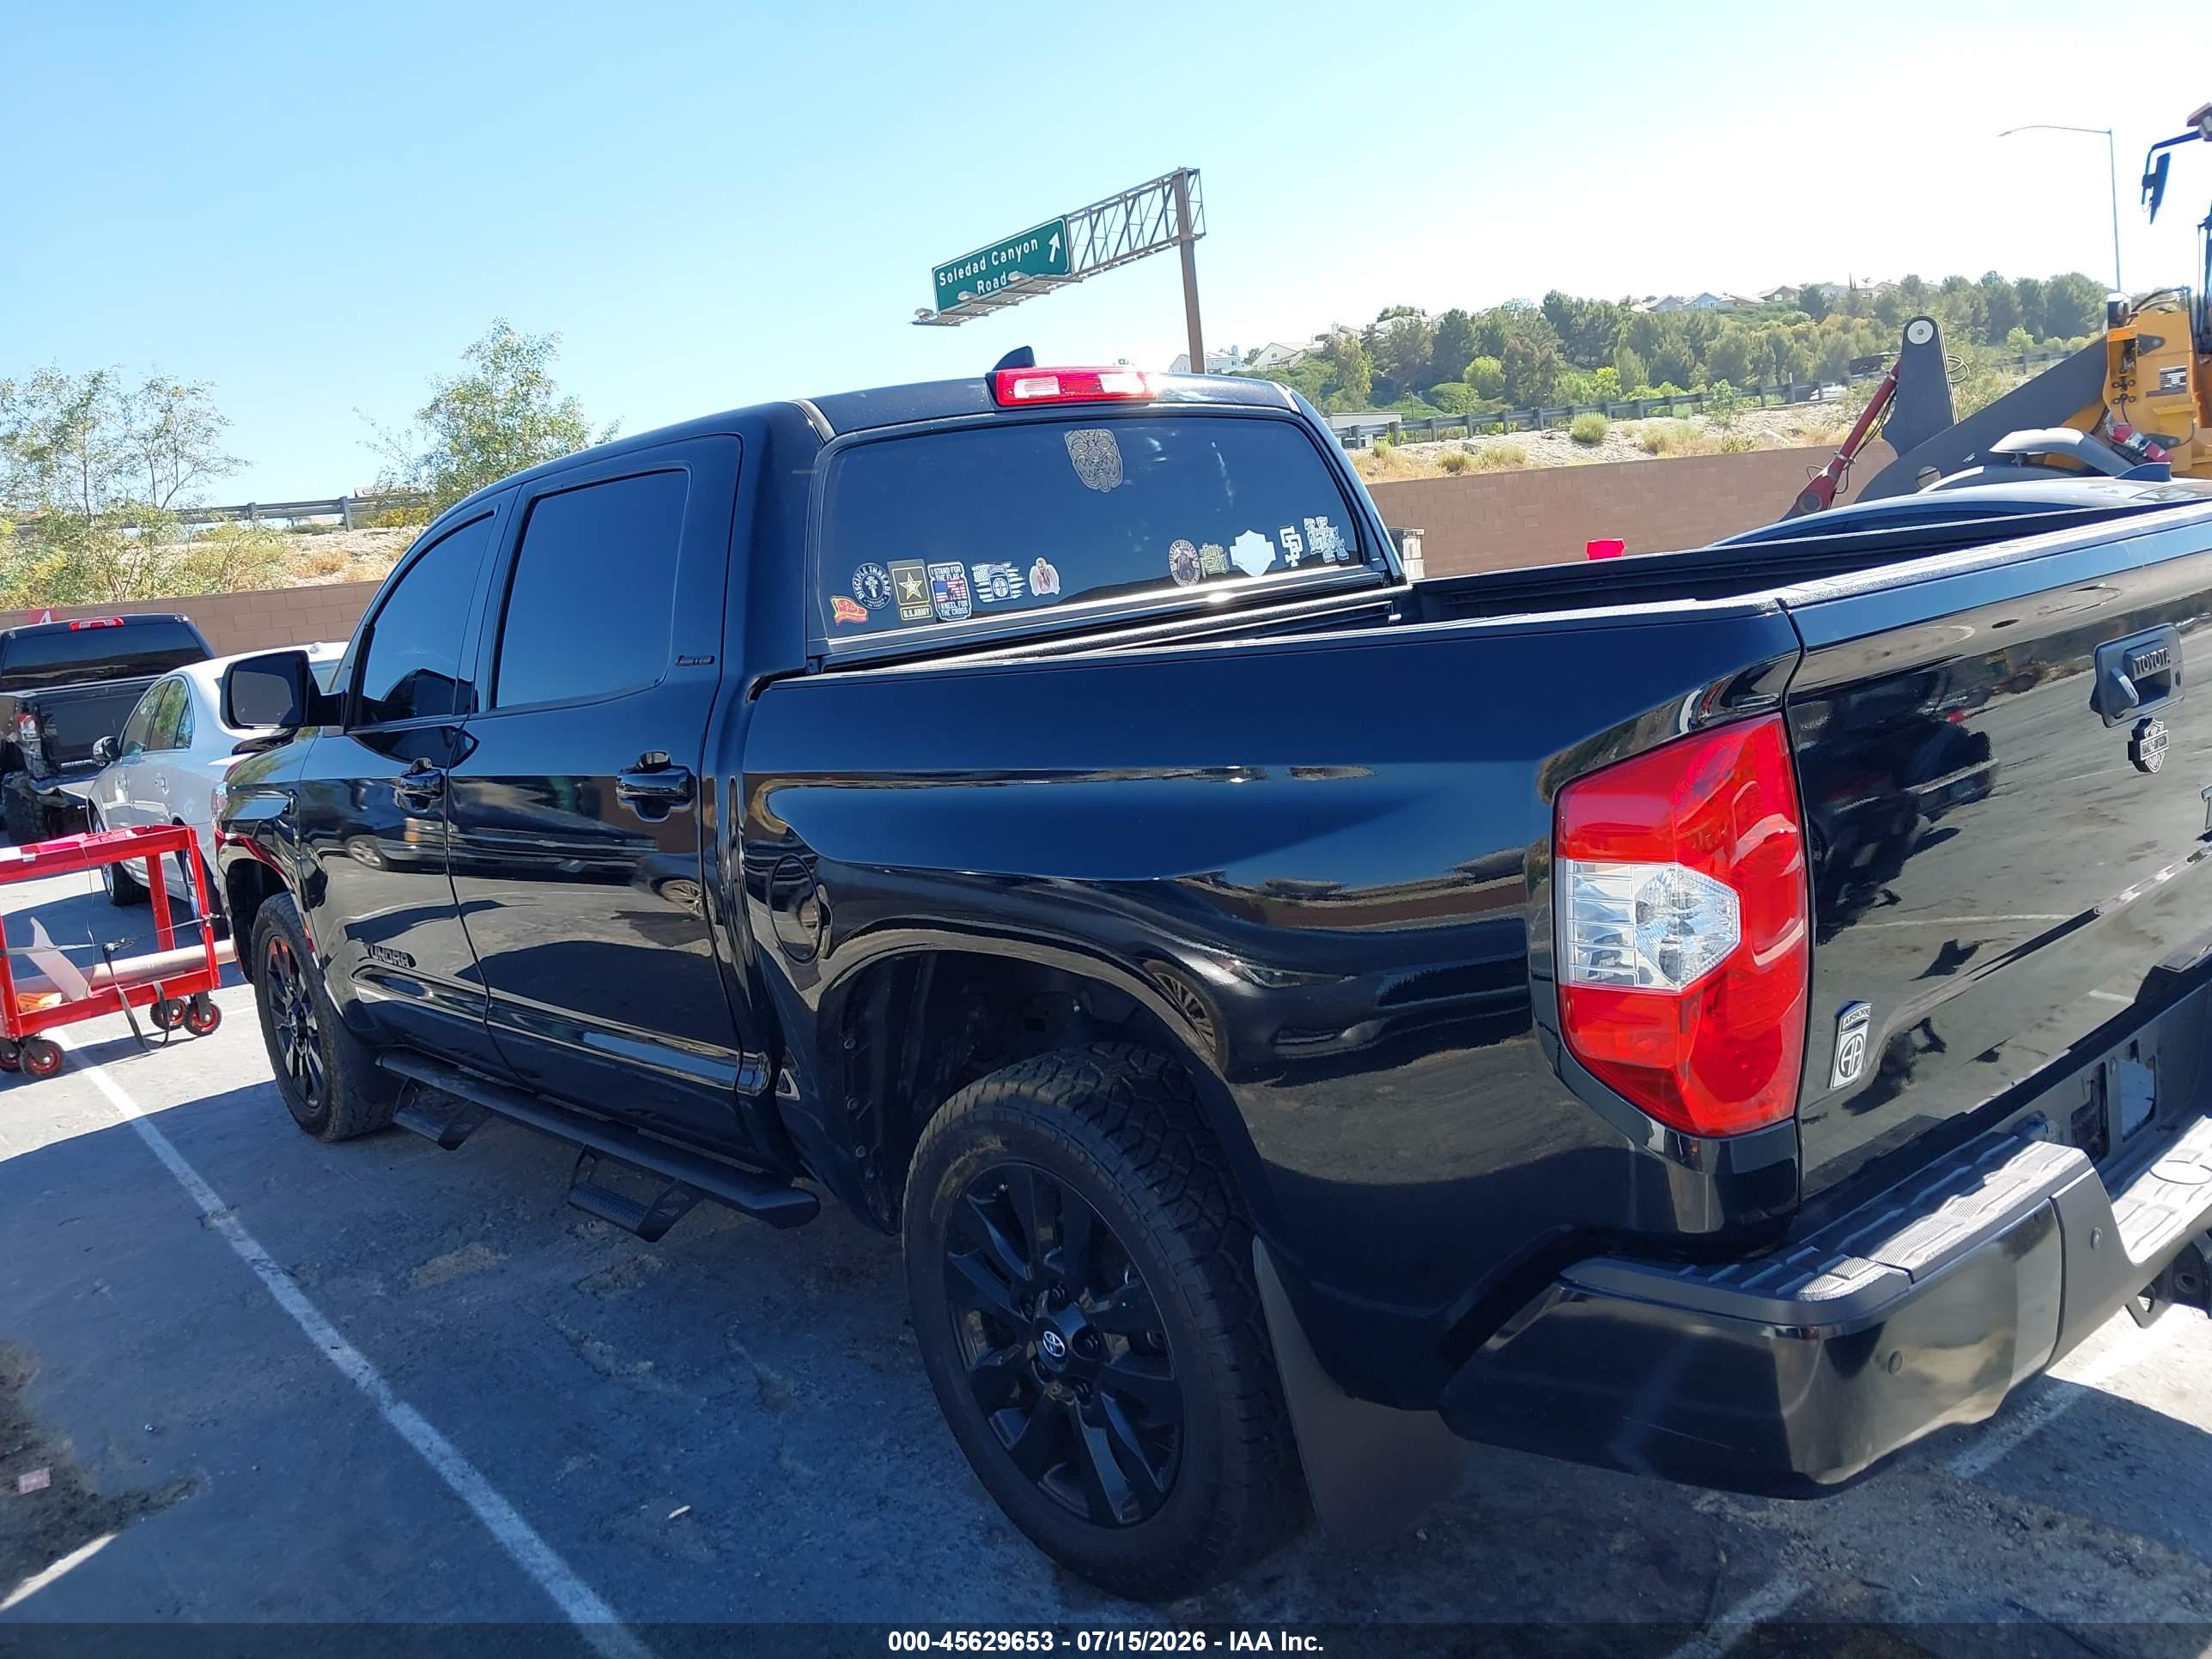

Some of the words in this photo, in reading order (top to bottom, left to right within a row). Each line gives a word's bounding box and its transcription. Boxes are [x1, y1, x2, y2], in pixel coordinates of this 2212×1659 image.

[939, 256, 987, 287] Soledad
[991, 238, 1038, 266] Canyon
[976, 271, 1007, 295] Road
[854, 567, 868, 599] DISCIPLE
[868, 565, 890, 596] THREADS
[934, 567, 951, 575] STAND
[940, 601, 957, 610] KNEEL
[951, 607, 969, 616] CROSS
[2135, 647, 2172, 673] TOYOTA
[364, 944, 410, 968] UNDRA
